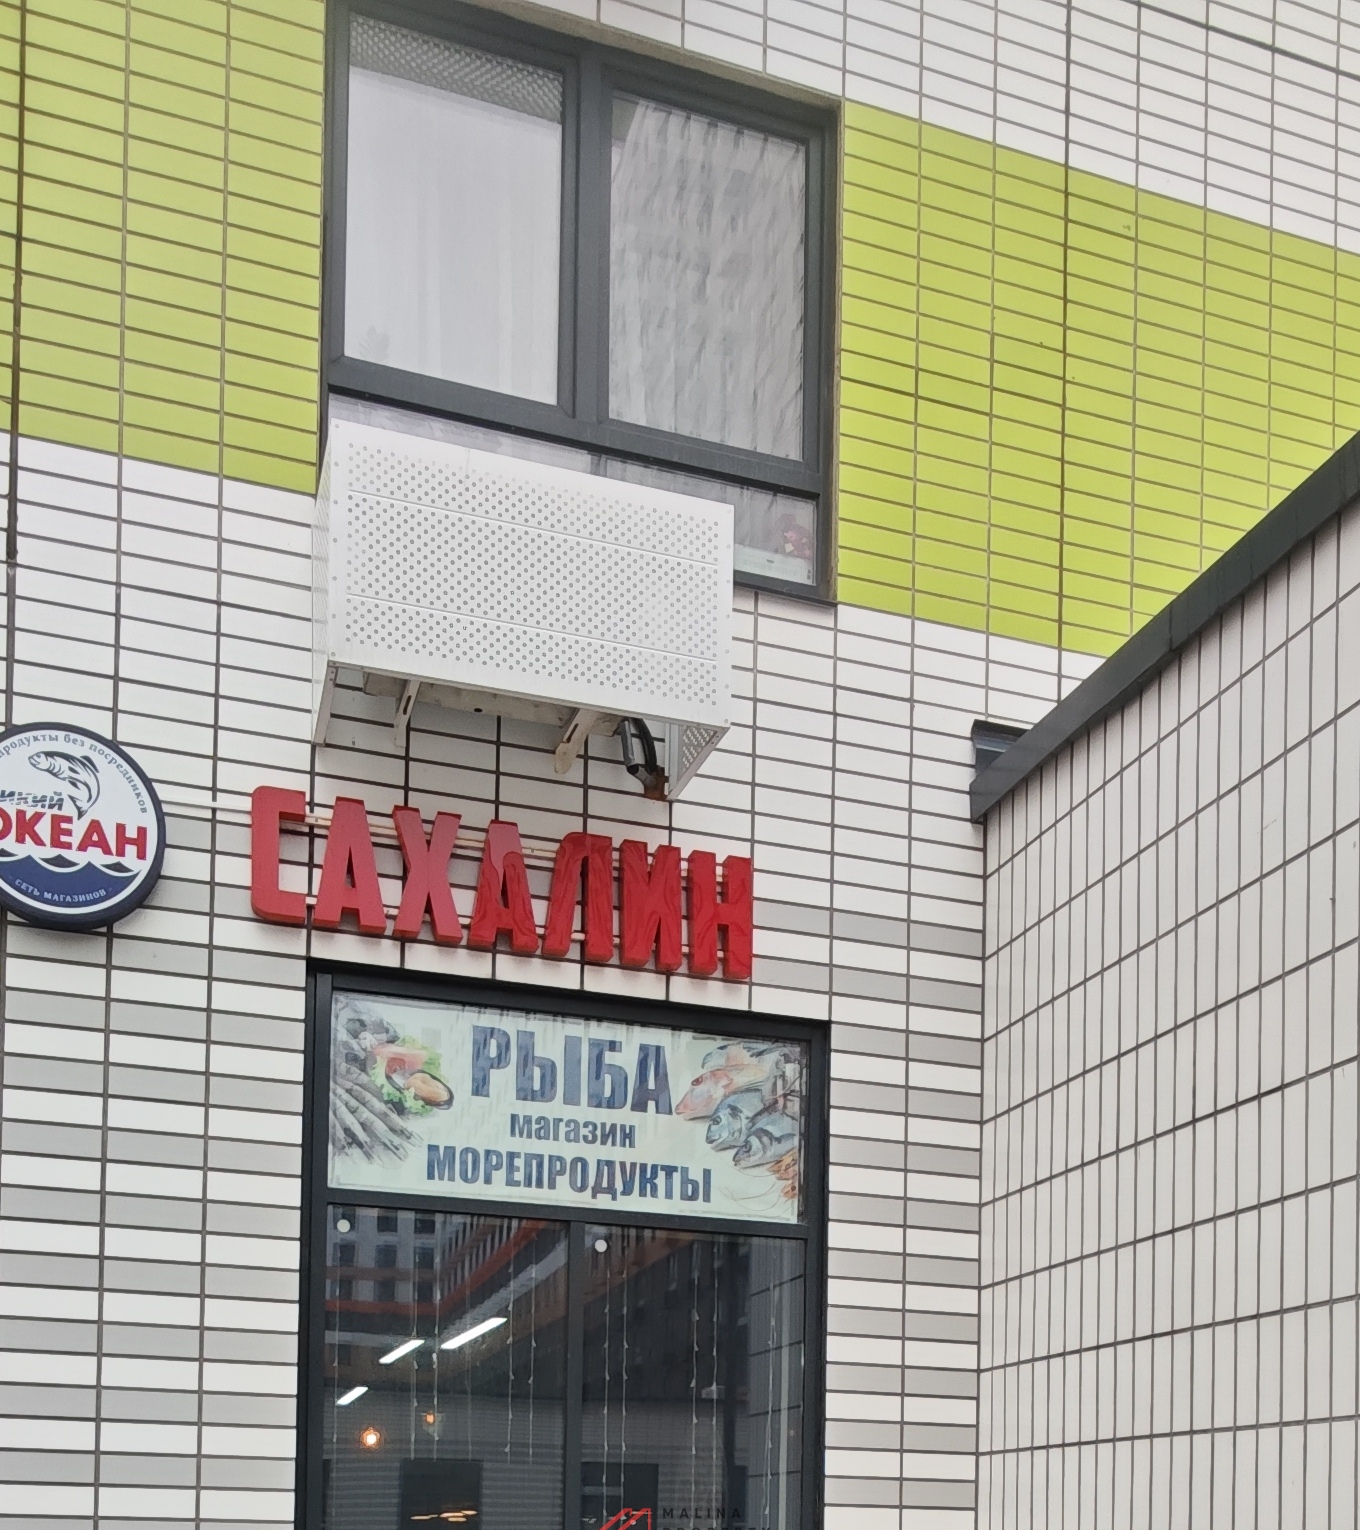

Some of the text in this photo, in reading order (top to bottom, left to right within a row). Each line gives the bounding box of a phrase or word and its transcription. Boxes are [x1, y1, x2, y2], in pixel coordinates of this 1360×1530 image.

[63, 733, 85, 748] без
[88, 742, 148, 814] посредников
[14, 878, 107, 903] СЕТЬ МАГАЗИНОВ
[251, 785, 754, 981] САХАЛИН
[470, 1024, 674, 1116] РЫБА
[509, 1113, 636, 1149] магазин
[426, 1144, 713, 1204] МОРЕПРОДУКТЫ
